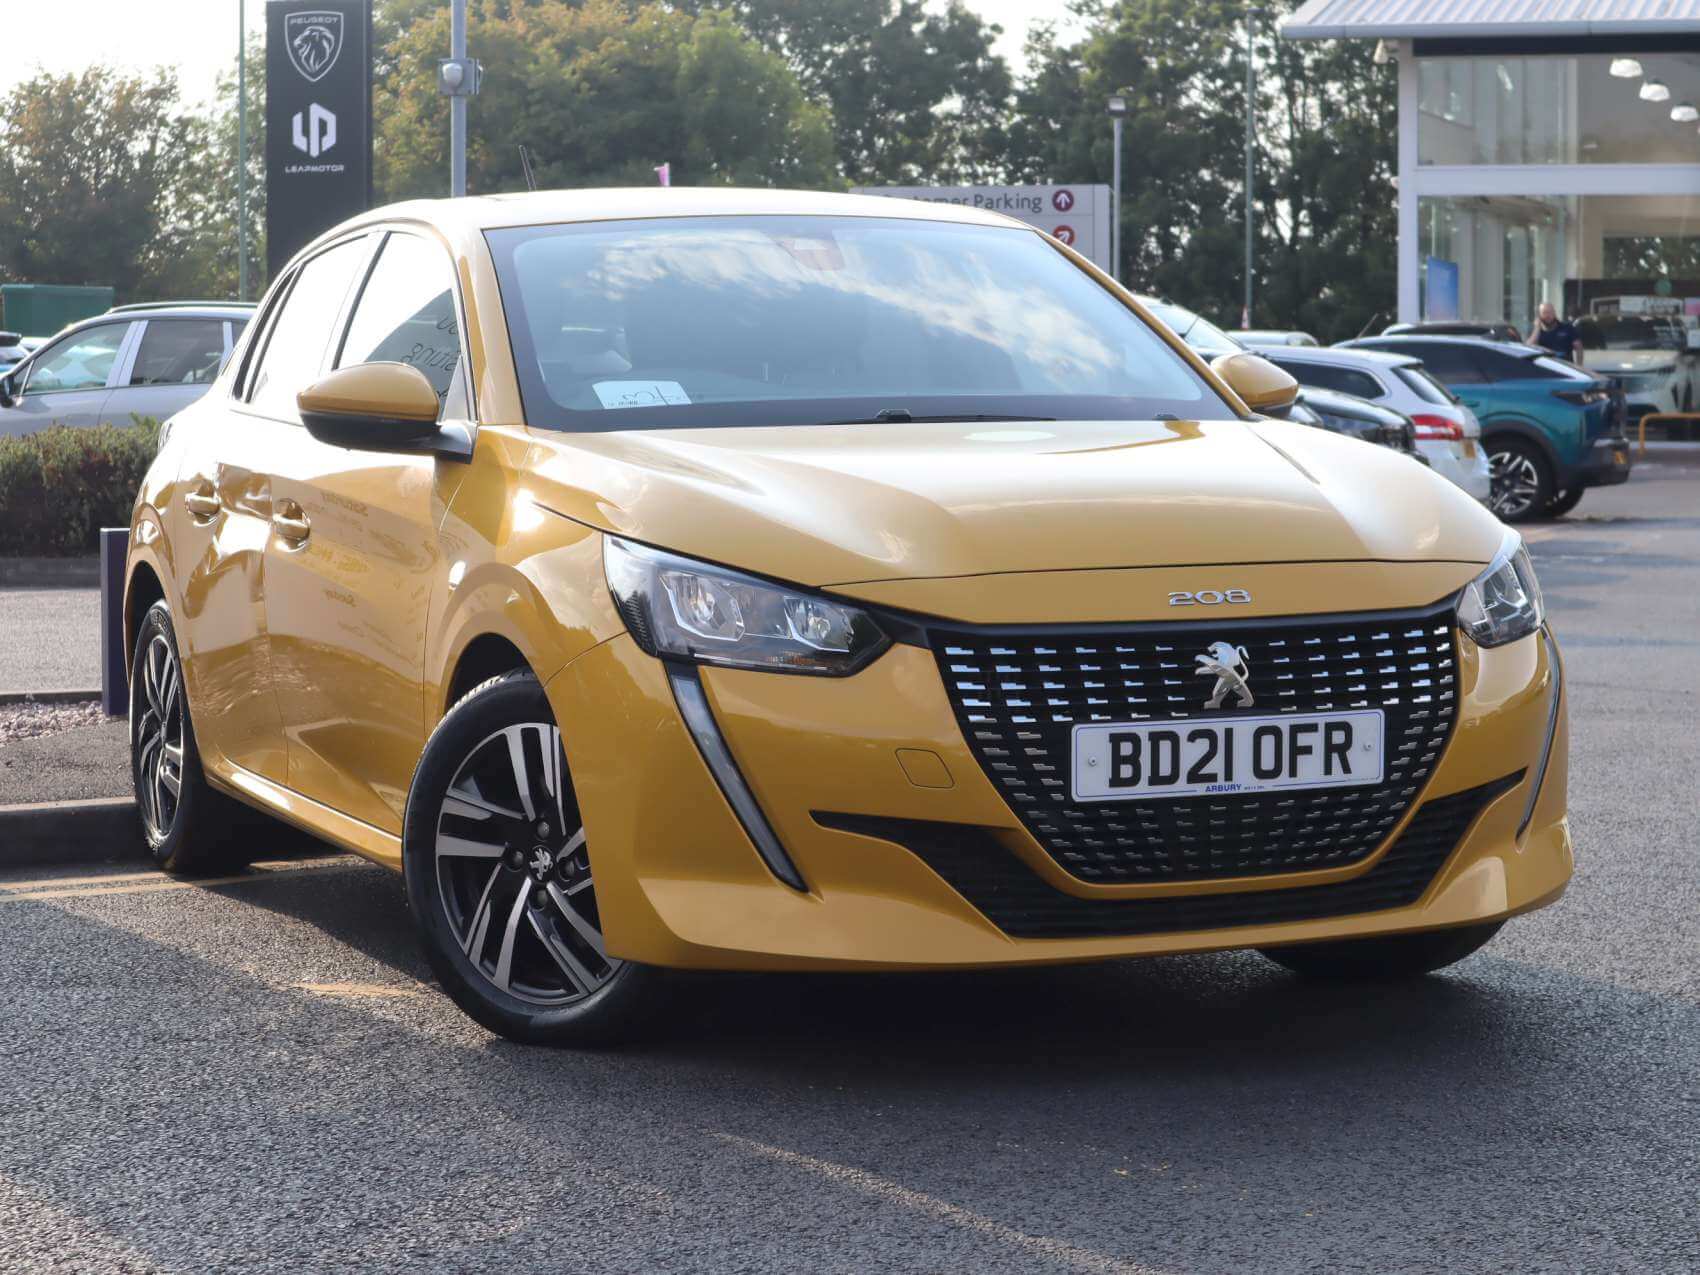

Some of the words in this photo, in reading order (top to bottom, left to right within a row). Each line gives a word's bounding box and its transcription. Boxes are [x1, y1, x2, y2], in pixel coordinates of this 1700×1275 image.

[290, 16, 338, 25] PEUGEOT
[285, 164, 345, 173] LEAPMOTOR
[973, 193, 1043, 214] Parking
[1167, 588, 1251, 606] 208
[1108, 728, 1234, 788] BD21
[1252, 720, 1353, 780] OFR
[1205, 783, 1242, 793] ARBURY
